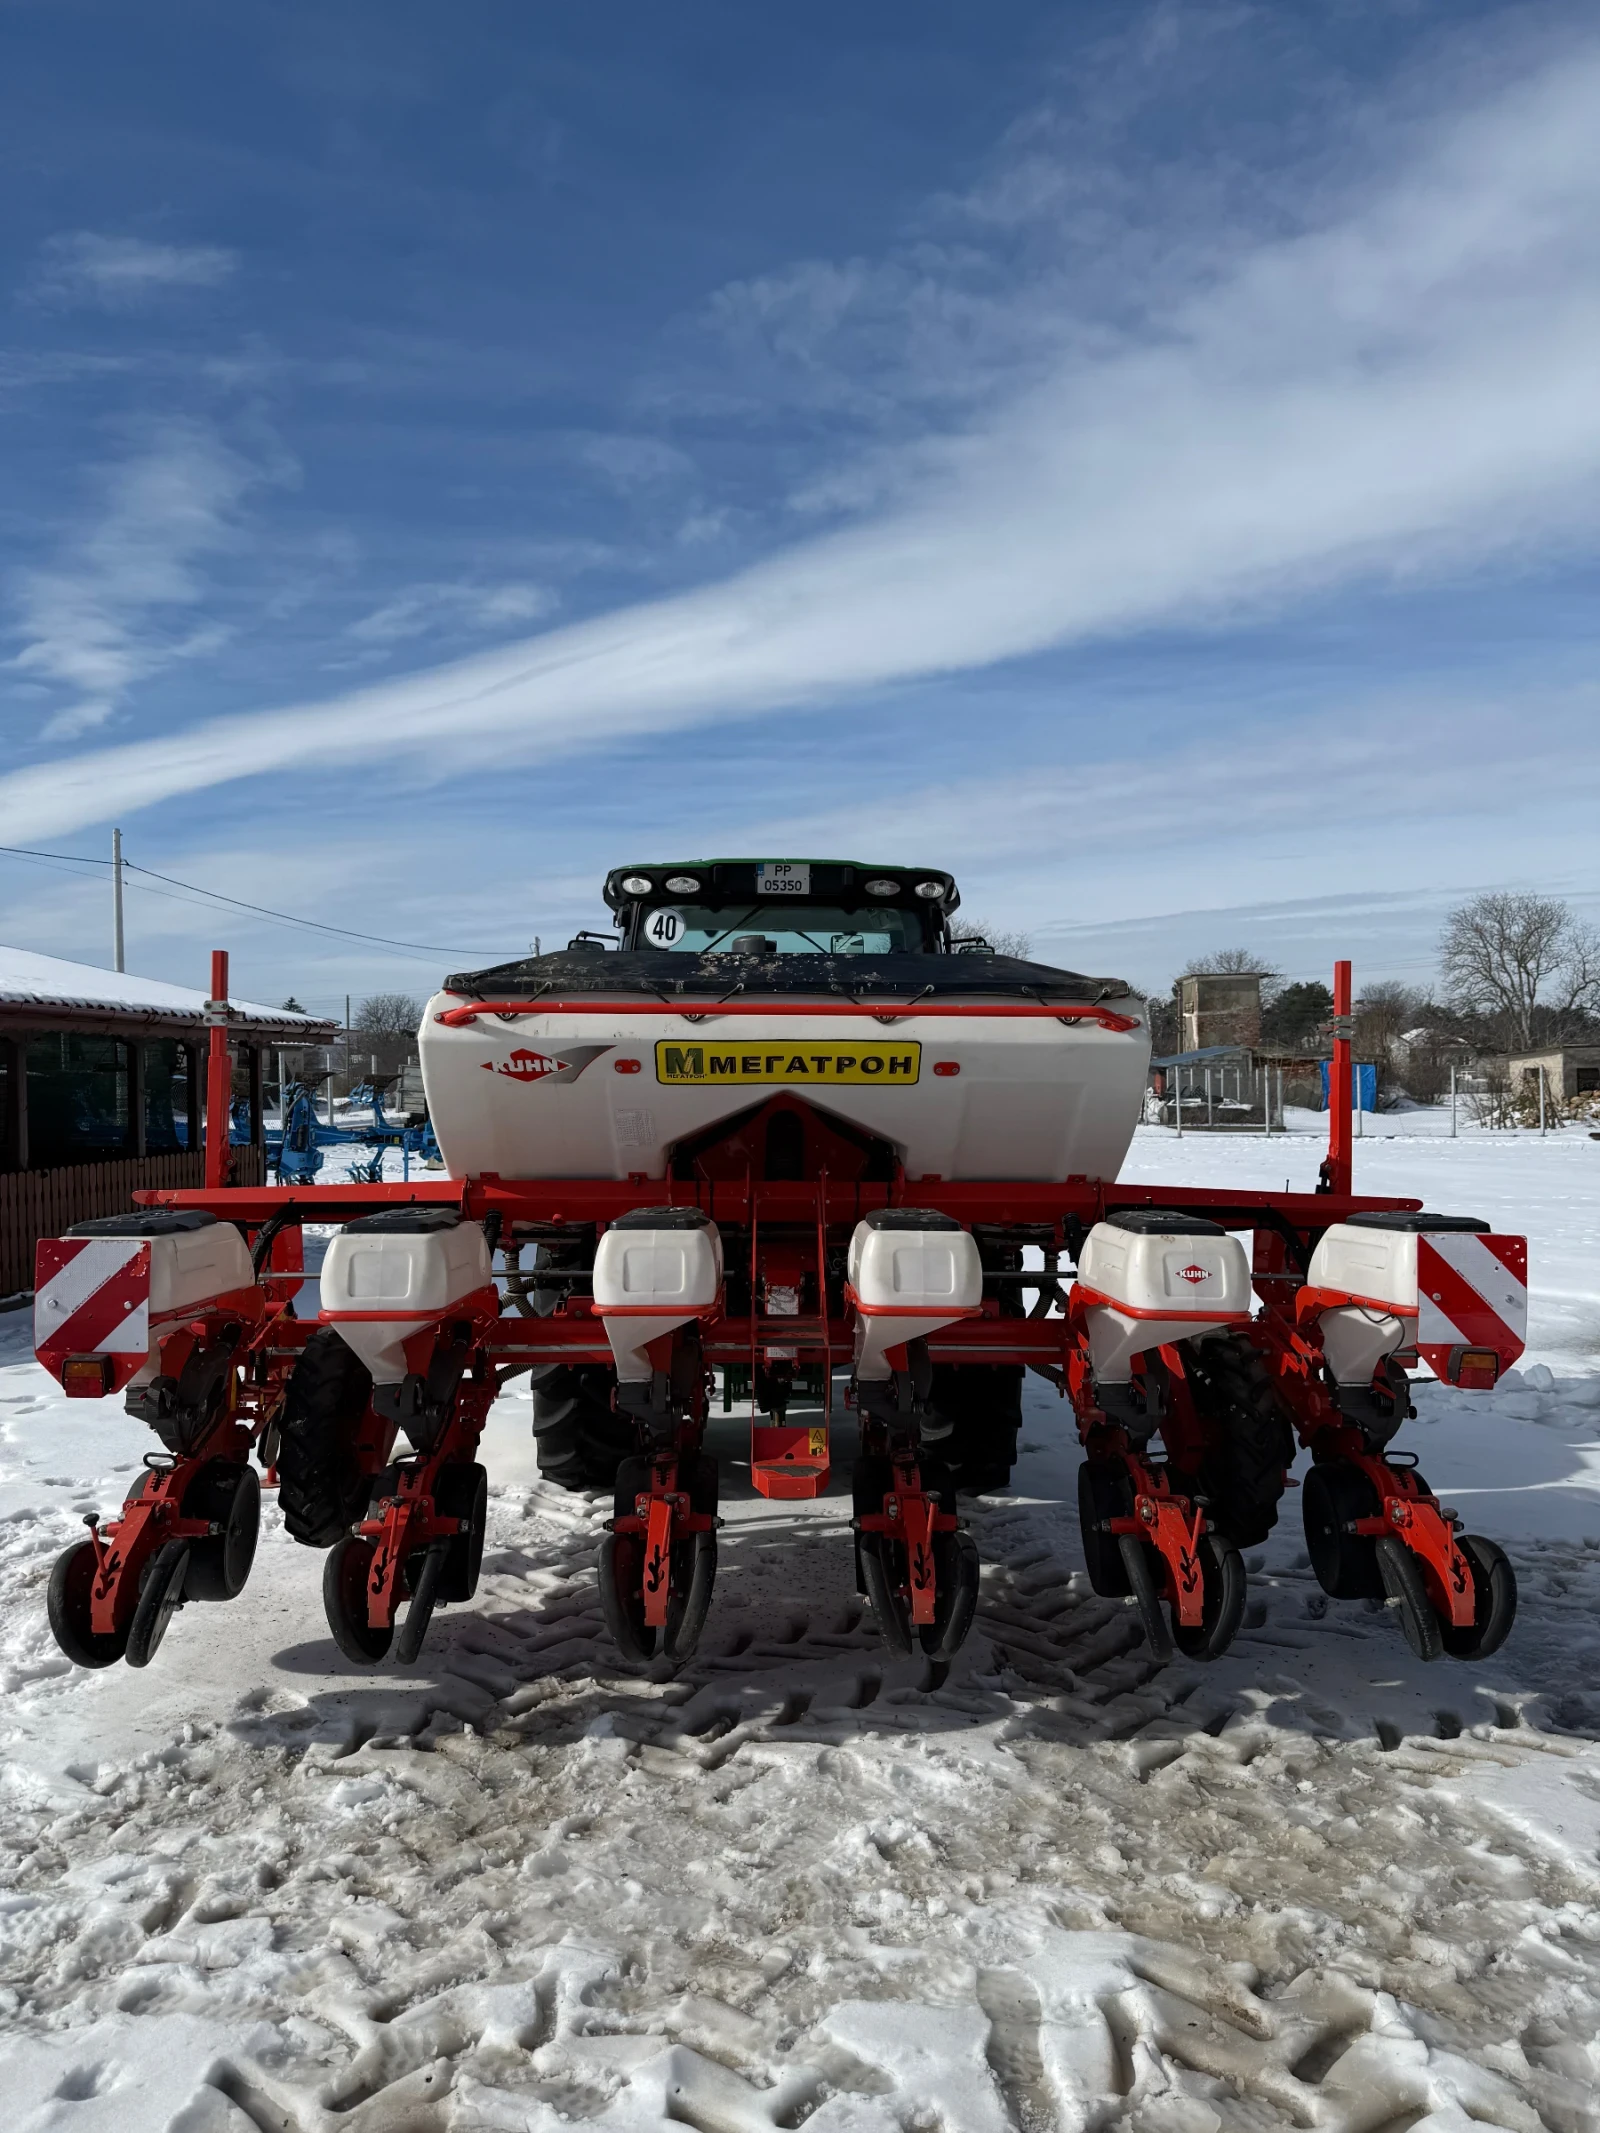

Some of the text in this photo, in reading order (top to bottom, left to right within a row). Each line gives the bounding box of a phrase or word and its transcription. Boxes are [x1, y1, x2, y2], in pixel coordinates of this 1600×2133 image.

[774, 865, 792, 876] PP
[764, 880, 802, 891] 05350
[652, 915, 677, 941] 40
[491, 1059, 559, 1072] KUHN
[709, 1056, 913, 1075] МЕГАТРОН
[1180, 1270, 1209, 1279] KUHN
